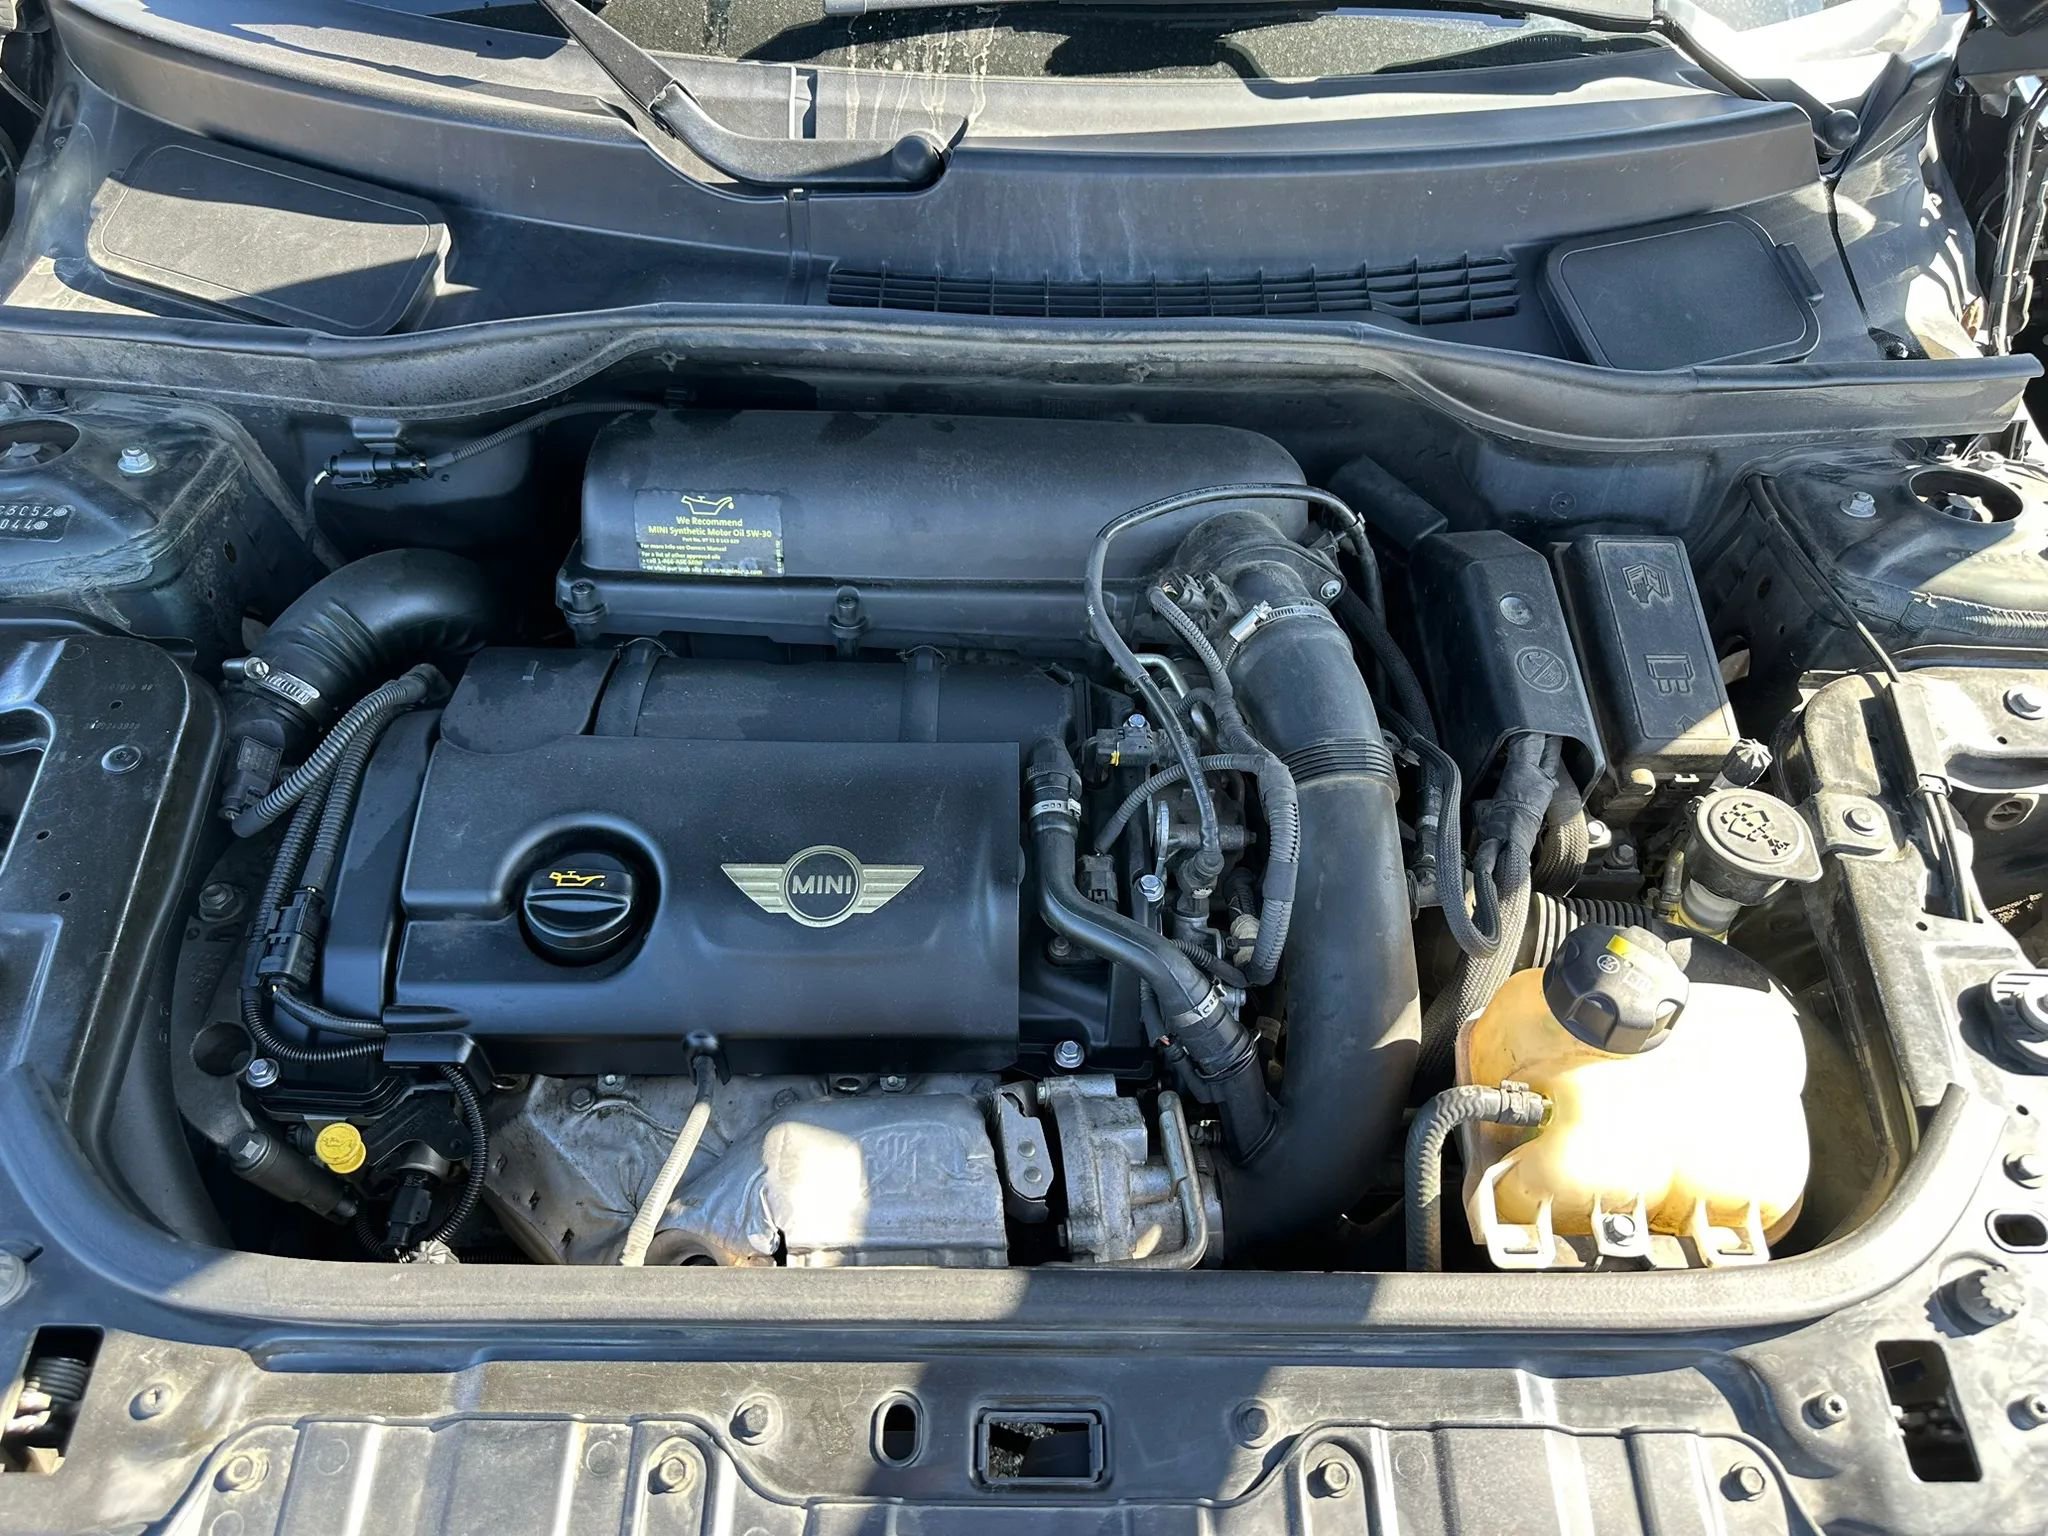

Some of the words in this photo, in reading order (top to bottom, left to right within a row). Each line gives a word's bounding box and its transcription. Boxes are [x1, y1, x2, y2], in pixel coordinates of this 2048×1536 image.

[675, 515, 691, 525] We
[691, 516, 743, 527] Recommend
[648, 525, 669, 535] MINI
[669, 526, 706, 537] Synthetic
[707, 527, 732, 537] Motor
[733, 528, 745, 537] Oil
[745, 529, 772, 538] 5W-30
[792, 875, 851, 894] MINI
